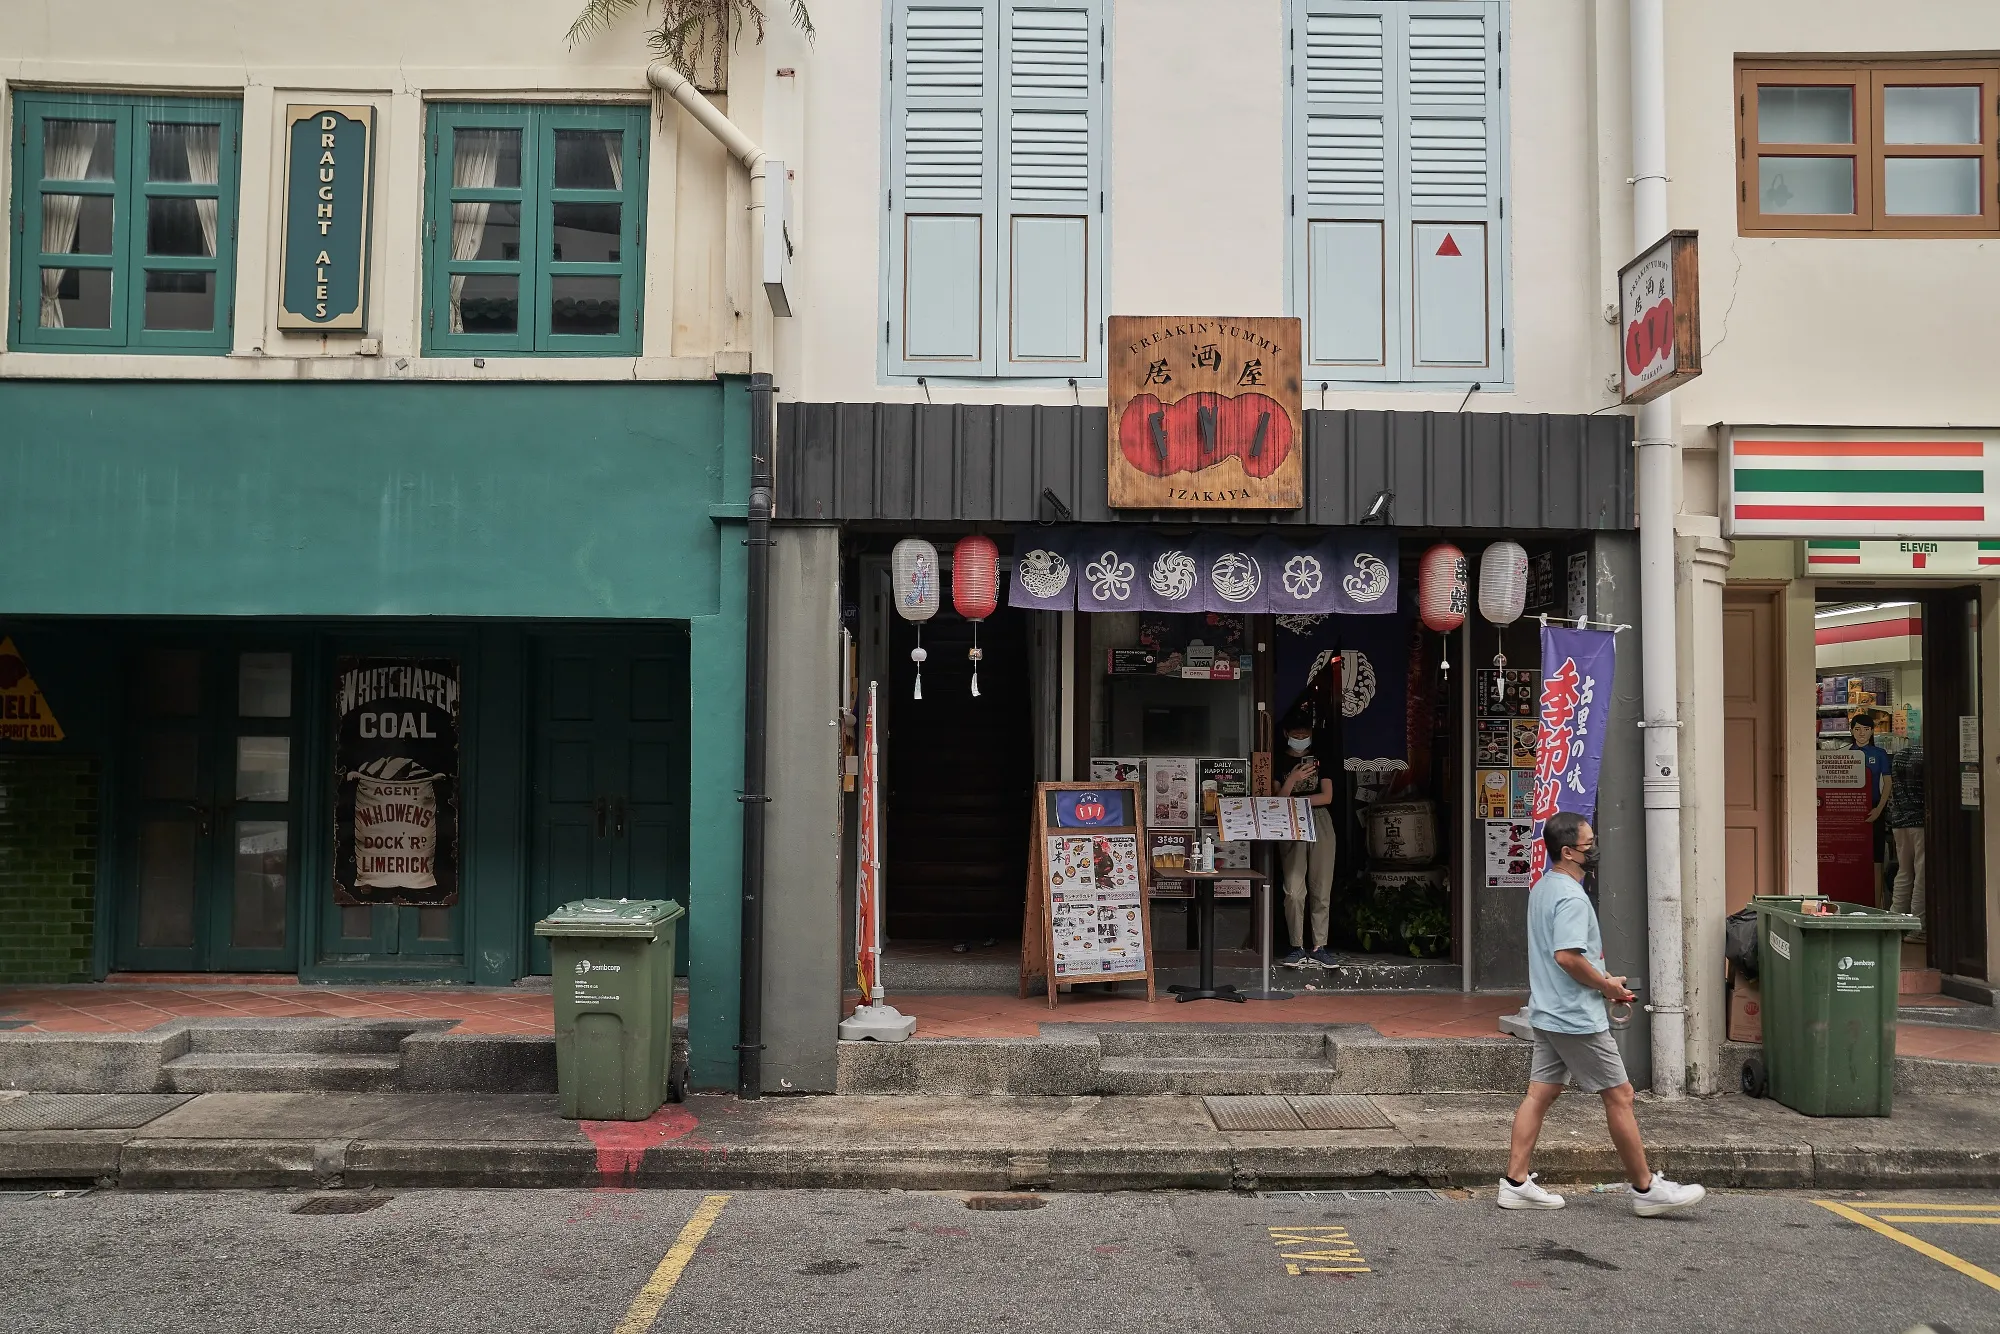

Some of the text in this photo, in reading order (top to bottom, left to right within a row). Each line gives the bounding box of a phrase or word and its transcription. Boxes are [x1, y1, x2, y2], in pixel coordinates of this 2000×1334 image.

[315, 115, 338, 319] DRAUGHT ALES
[1217, 324, 1283, 357] YUMMY
[1167, 487, 1251, 502] IZAKAYA
[341, 665, 459, 718] WHITEHAVEN
[0, 695, 41, 719] ELL
[30, 724, 39, 738] &
[40, 724, 57, 738] OIL
[358, 711, 437, 739] COAL
[373, 786, 420, 796] AGENT
[364, 835, 403, 850] DOCK
[1157, 835, 1164, 844] 3
[1167, 835, 1185, 844] $30
[362, 856, 430, 874] LIMERICK
[592, 963, 621, 973] sembcorp
